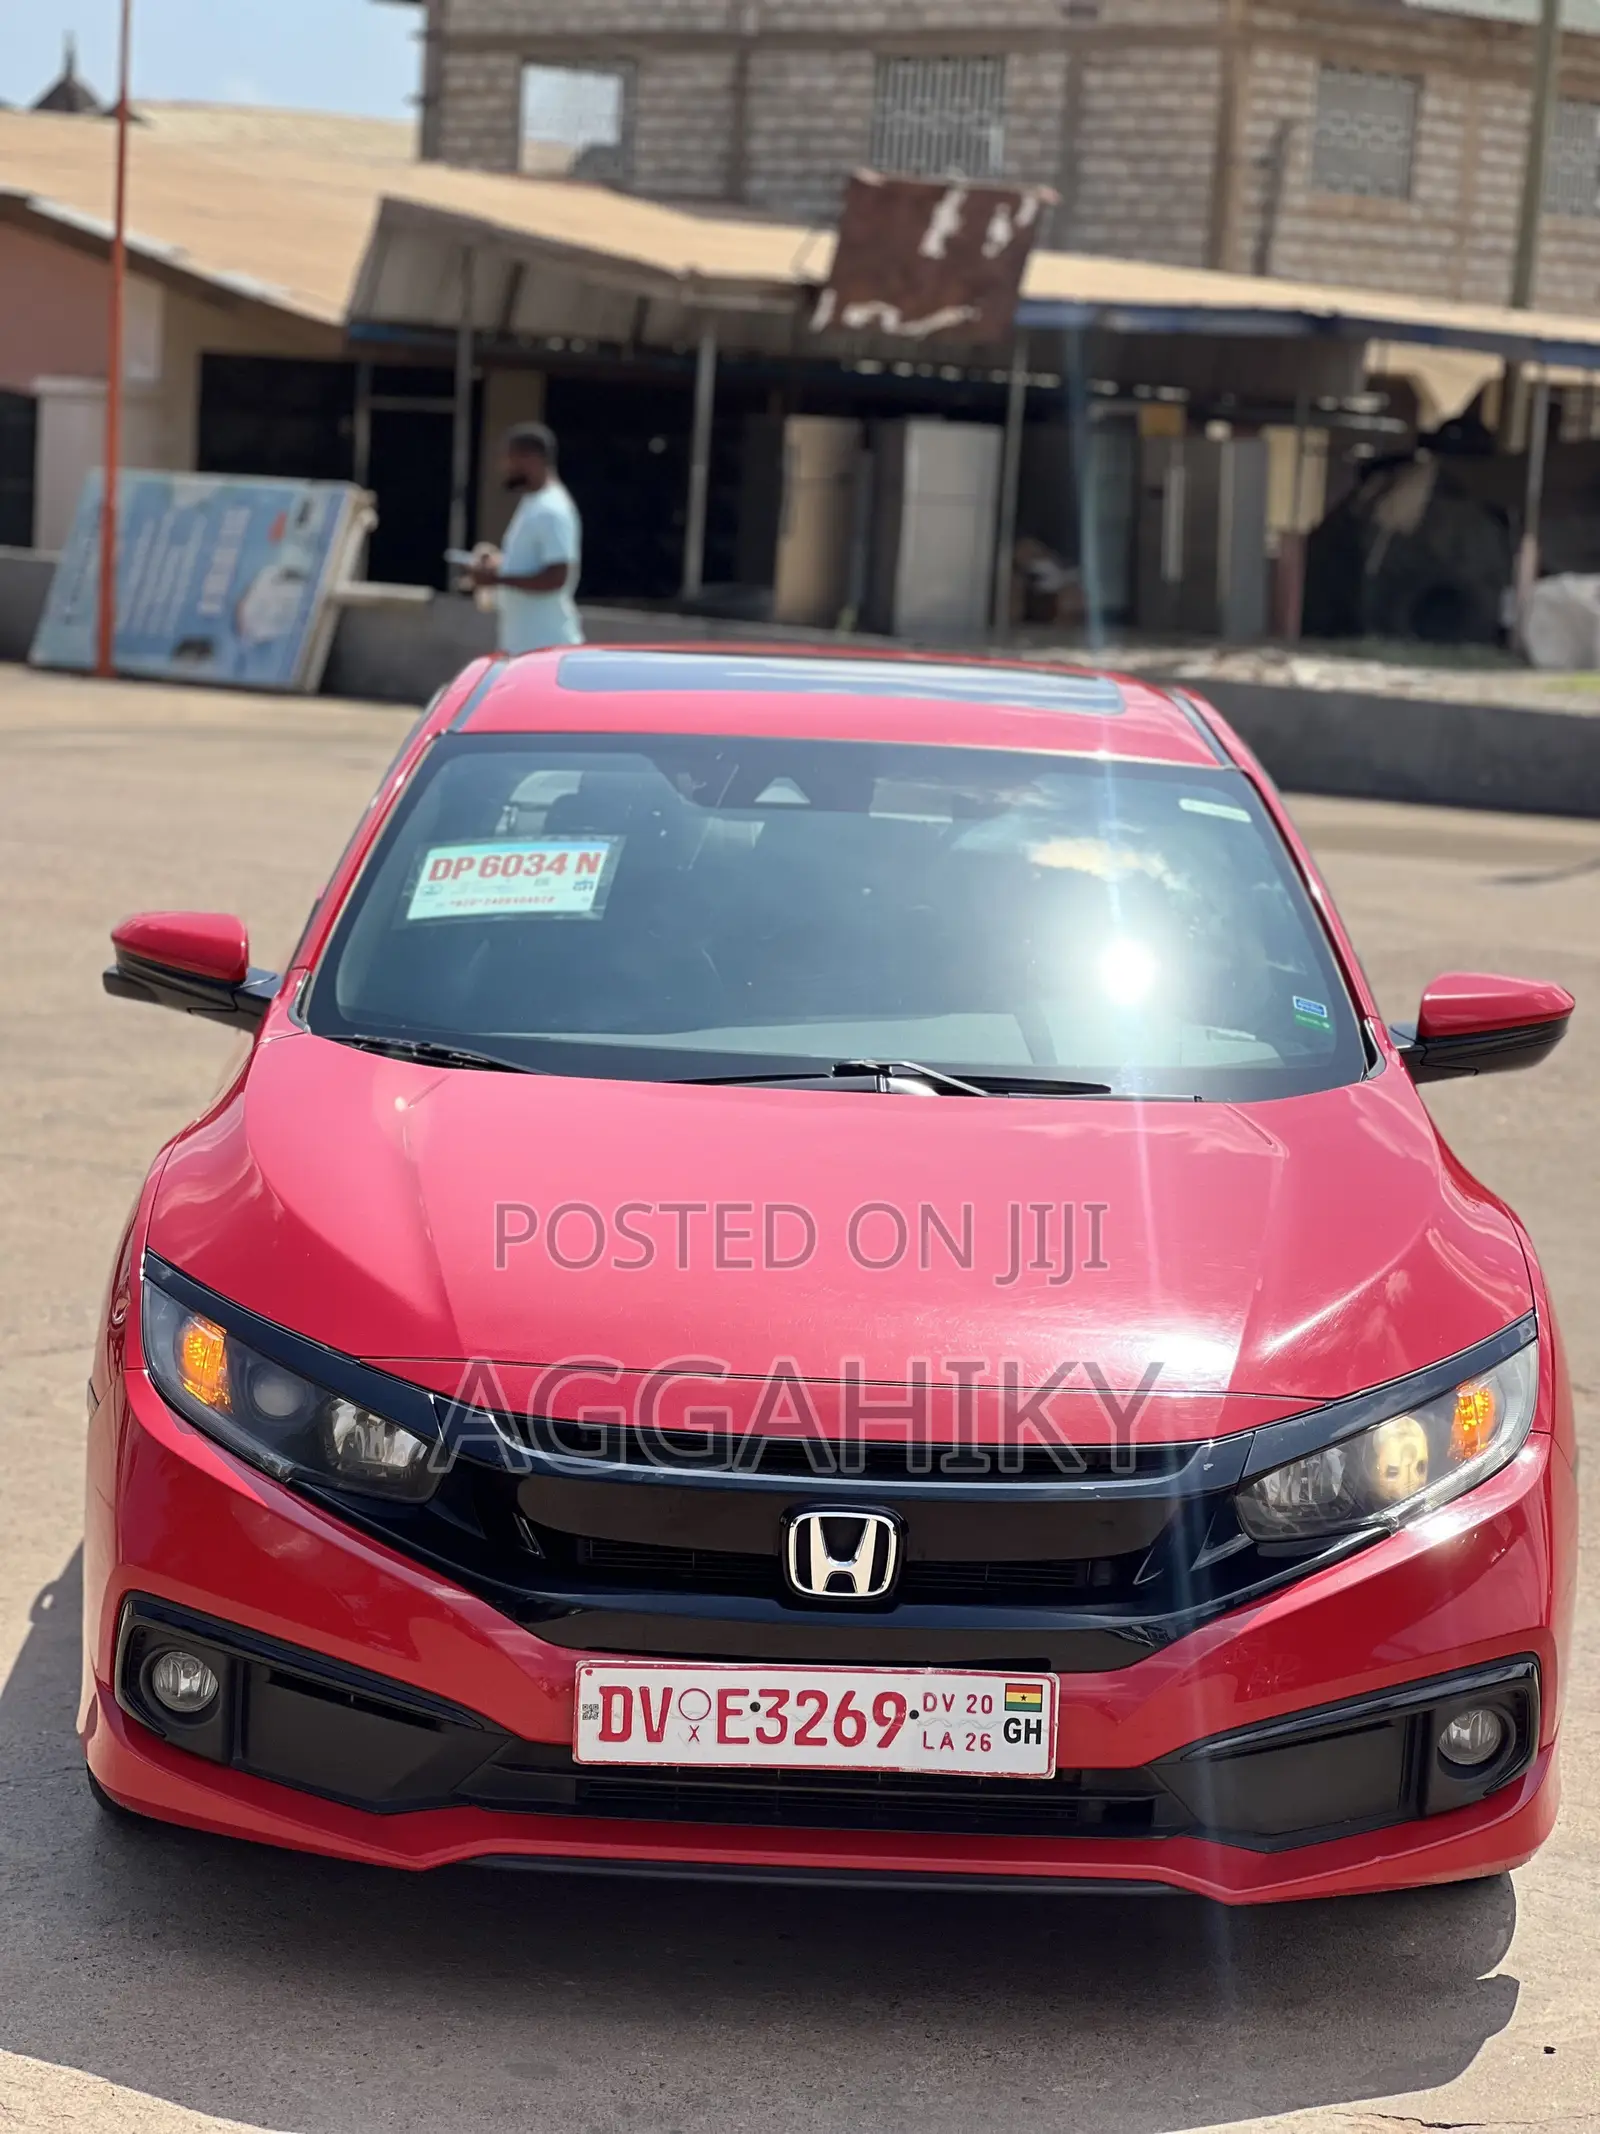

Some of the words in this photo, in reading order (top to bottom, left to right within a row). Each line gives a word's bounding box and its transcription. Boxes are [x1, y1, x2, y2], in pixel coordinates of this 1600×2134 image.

[478, 853, 568, 878] 6034
[575, 852, 601, 875] N
[598, 1686, 674, 1743] DV
[922, 1692, 956, 1713] DV
[966, 1694, 994, 1715] 20
[922, 1731, 955, 1750] LA
[965, 1732, 993, 1752] 26
[1003, 1717, 1042, 1745] GH
